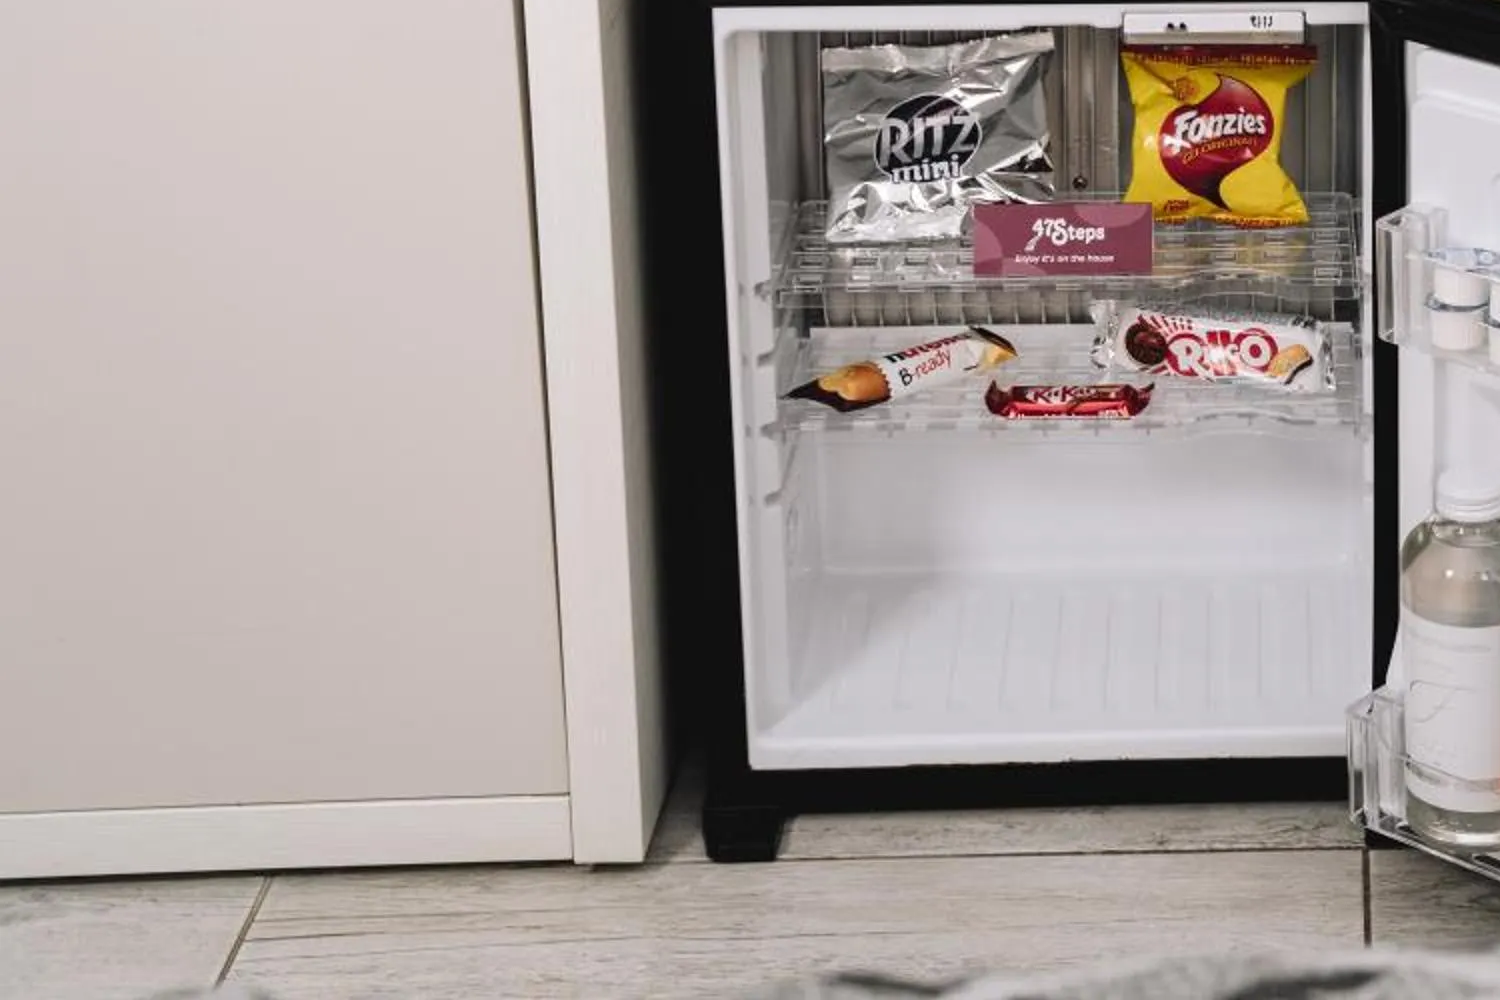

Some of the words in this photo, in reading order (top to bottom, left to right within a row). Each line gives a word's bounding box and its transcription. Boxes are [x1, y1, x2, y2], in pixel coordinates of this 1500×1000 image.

[878, 108, 978, 168] RITZ
[1163, 105, 1267, 155] Fonzies
[892, 153, 960, 184] mini
[1015, 254, 1040, 265] Enjoy
[1057, 255, 1068, 263] on
[1070, 254, 1084, 263] the
[1087, 254, 1114, 264] house
[1168, 334, 1273, 382] RGO
